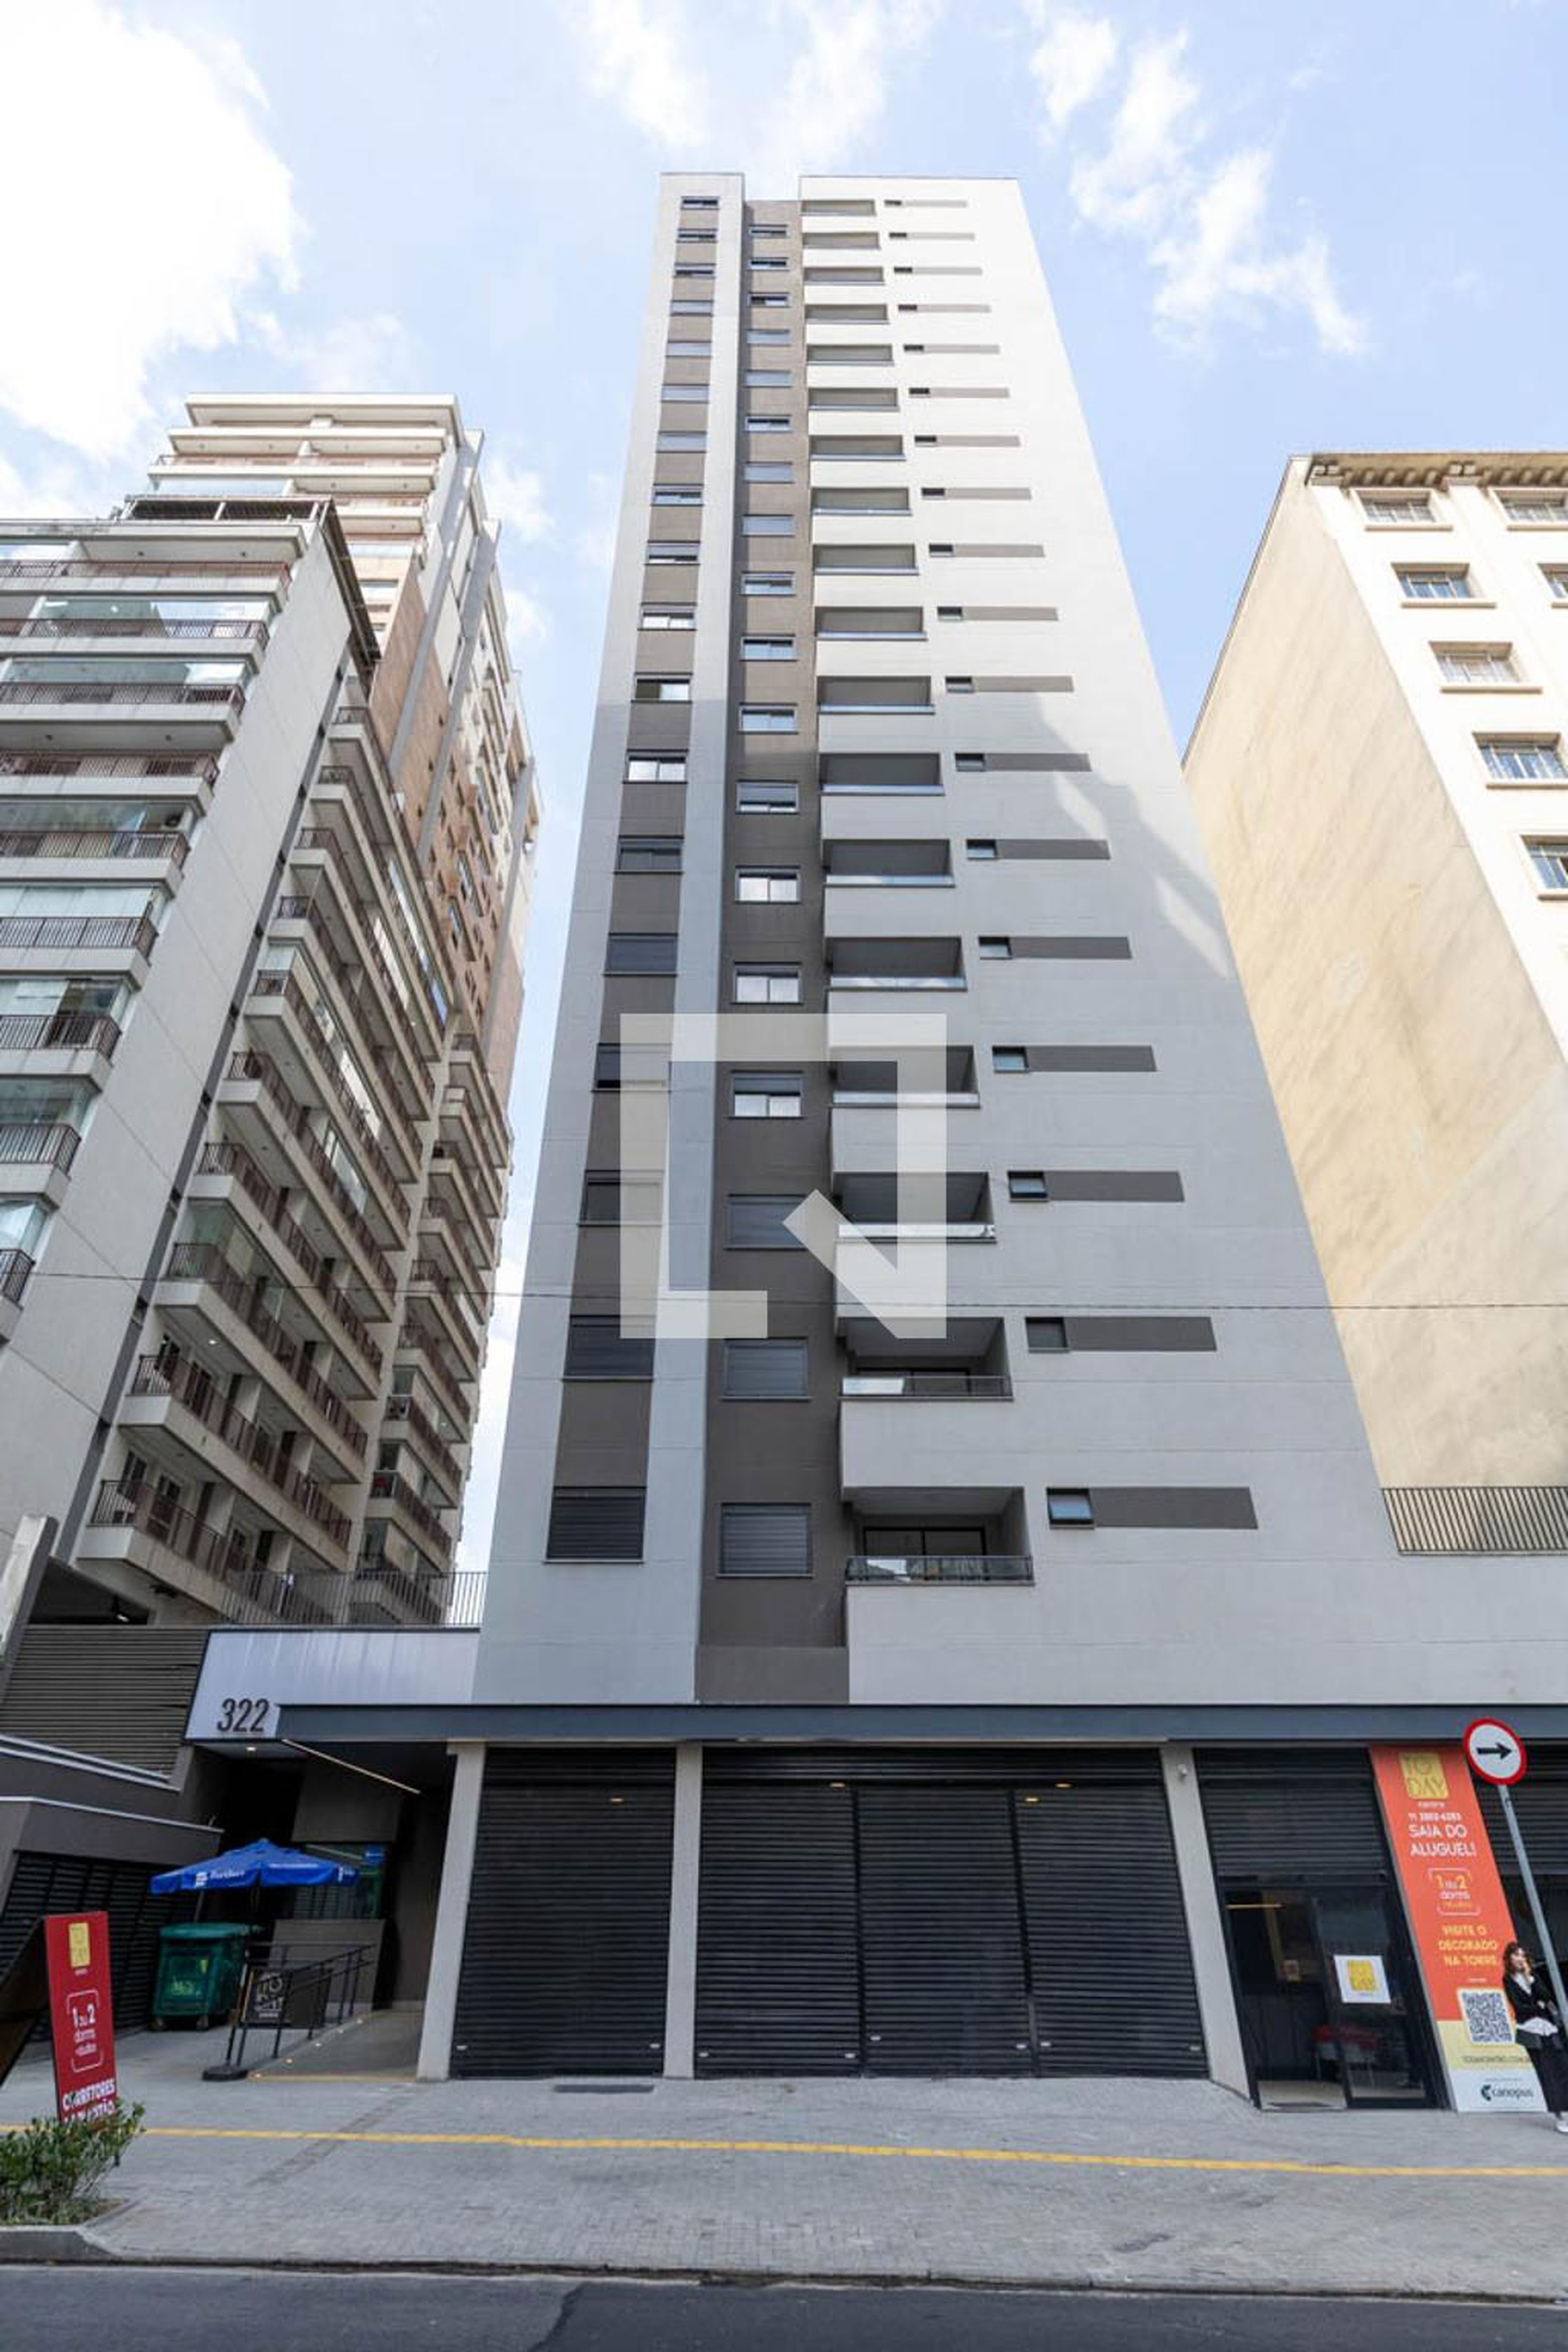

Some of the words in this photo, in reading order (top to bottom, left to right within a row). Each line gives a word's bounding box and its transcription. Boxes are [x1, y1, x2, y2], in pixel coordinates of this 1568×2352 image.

[217, 1698, 270, 1732] 322
[1408, 1824, 1443, 1838] SAIA
[1445, 1824, 1468, 1838] DO
[1476, 1925, 1487, 1936] O
[87, 2004, 96, 2024] 2
